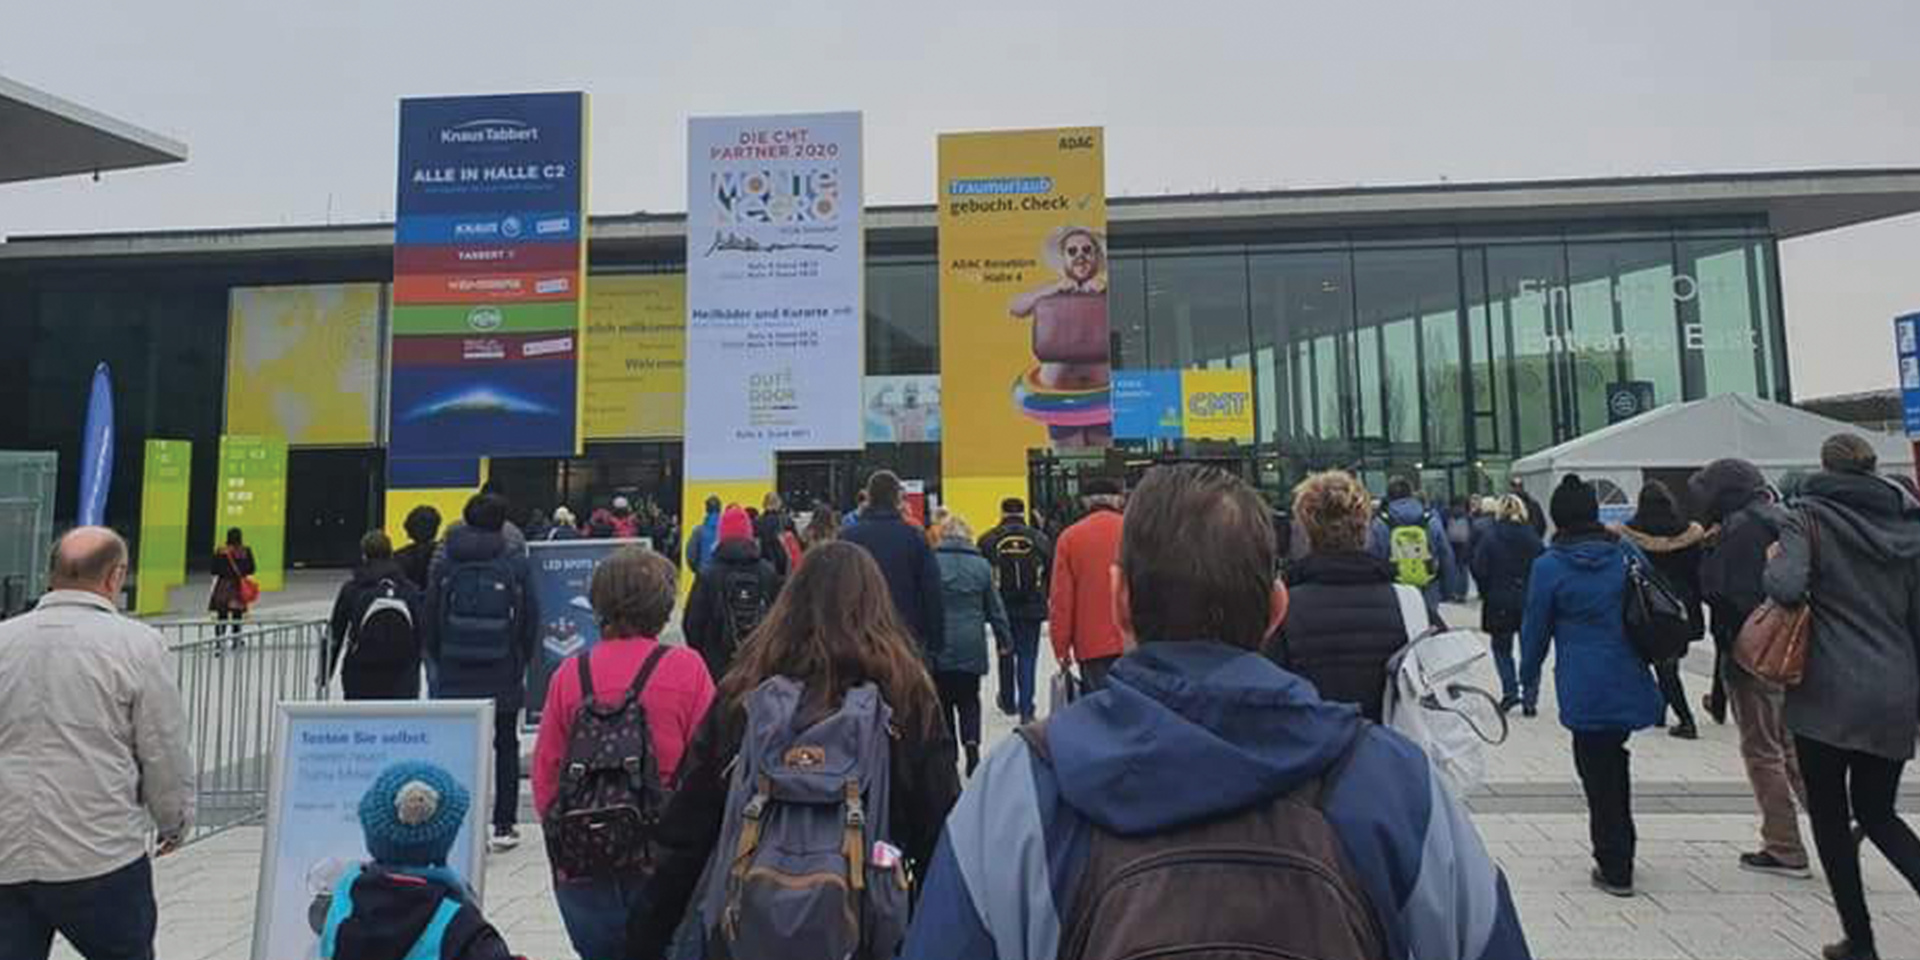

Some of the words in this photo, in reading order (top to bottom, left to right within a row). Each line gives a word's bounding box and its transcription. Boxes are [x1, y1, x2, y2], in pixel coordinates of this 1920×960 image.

[739, 132, 768, 145] DIE
[773, 130, 808, 143] CMT
[1058, 136, 1094, 149] ADAC
[710, 146, 790, 160] PARTNER
[794, 143, 839, 157] 2020
[413, 169, 455, 182] ALLE
[460, 168, 478, 181] IN
[484, 166, 539, 180] HALLE
[543, 165, 566, 178] C2
[950, 177, 1051, 194] Traumurlaub
[951, 198, 1018, 216] gebucht.
[1021, 195, 1070, 210] Check
[951, 260, 981, 270] ADAC
[755, 307, 779, 318] und
[1188, 391, 1249, 418] CMT
[543, 559, 561, 571] LED
[302, 731, 348, 745] Testen
[353, 730, 377, 744] Sie
